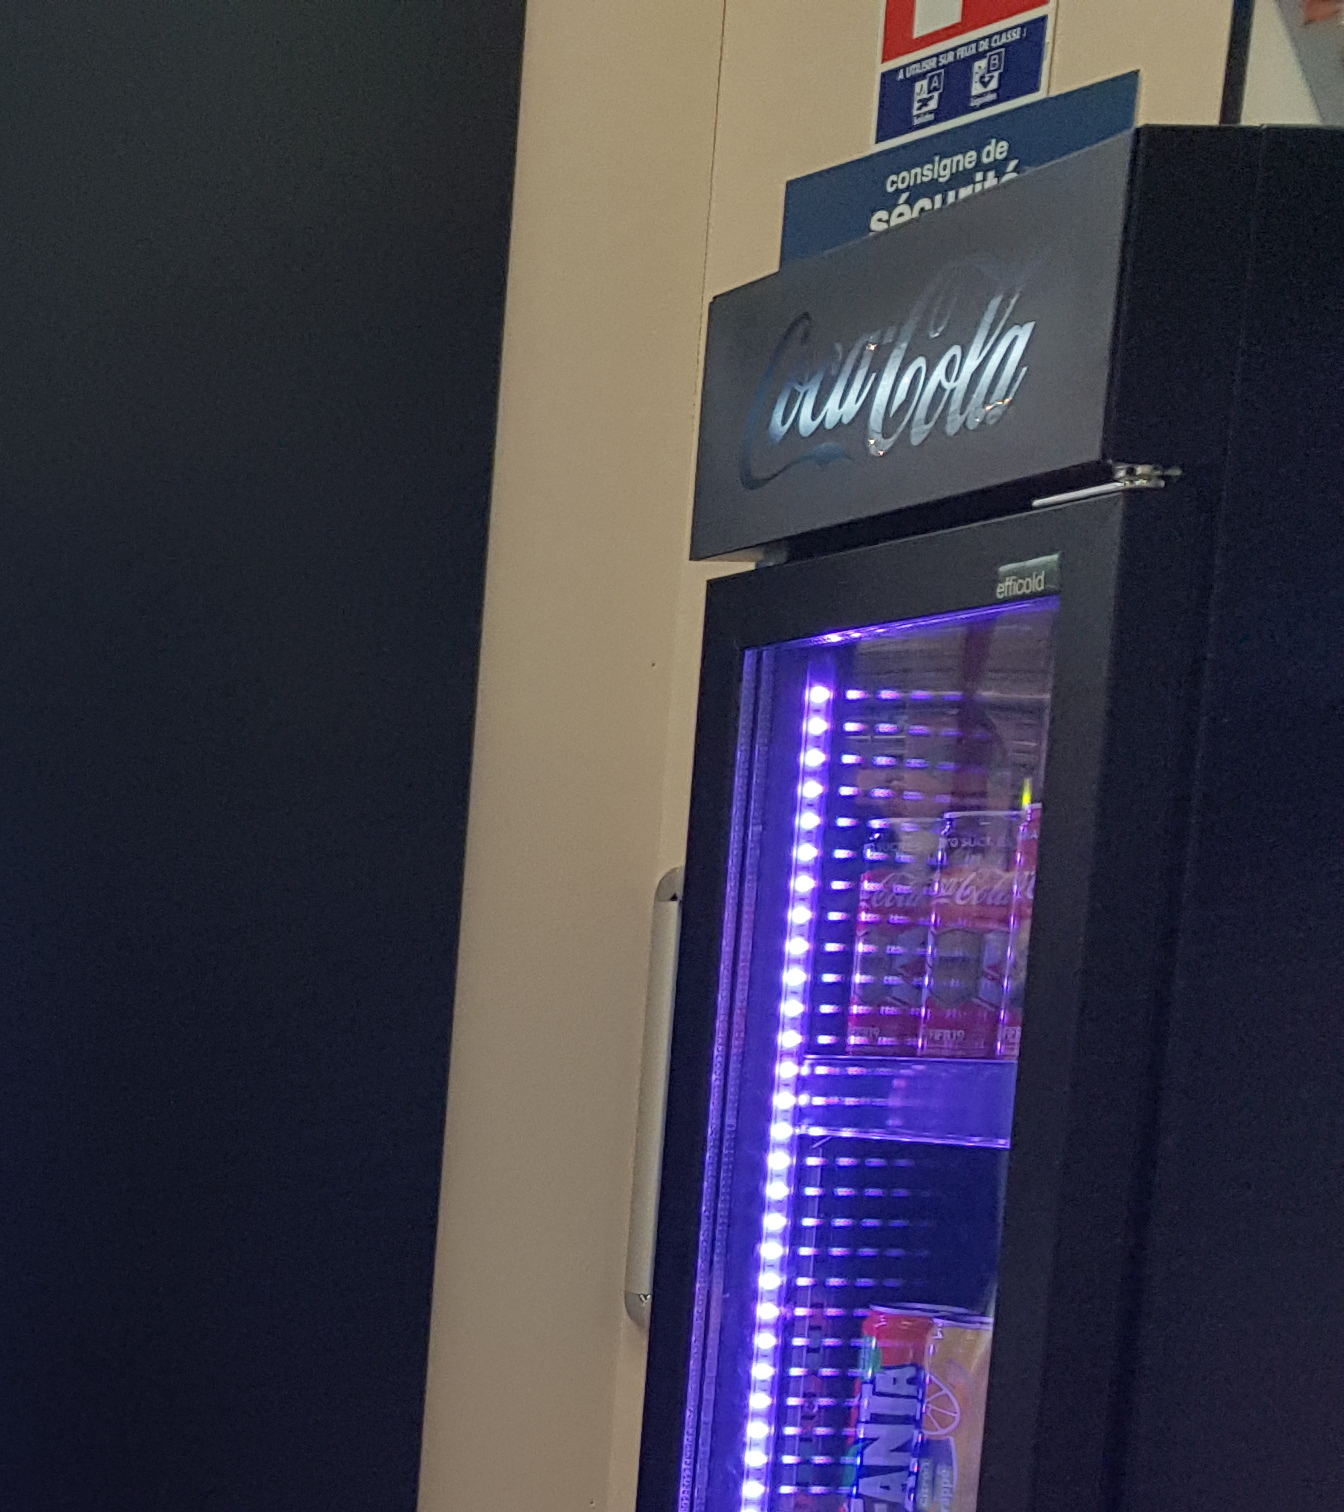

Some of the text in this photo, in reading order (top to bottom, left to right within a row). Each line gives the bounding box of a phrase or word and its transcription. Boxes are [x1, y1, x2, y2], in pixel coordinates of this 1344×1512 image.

[897, 68, 904, 81] A
[905, 57, 937, 79] UTILISER
[938, 51, 955, 68] SUR
[956, 42, 976, 60] FEUX
[978, 37, 991, 53] DE
[991, 26, 1022, 49] CLASSE
[989, 56, 1000, 71] B
[929, 74, 939, 91] A
[886, 138, 1010, 194] consigne de
[996, 570, 1046, 600] efficold
